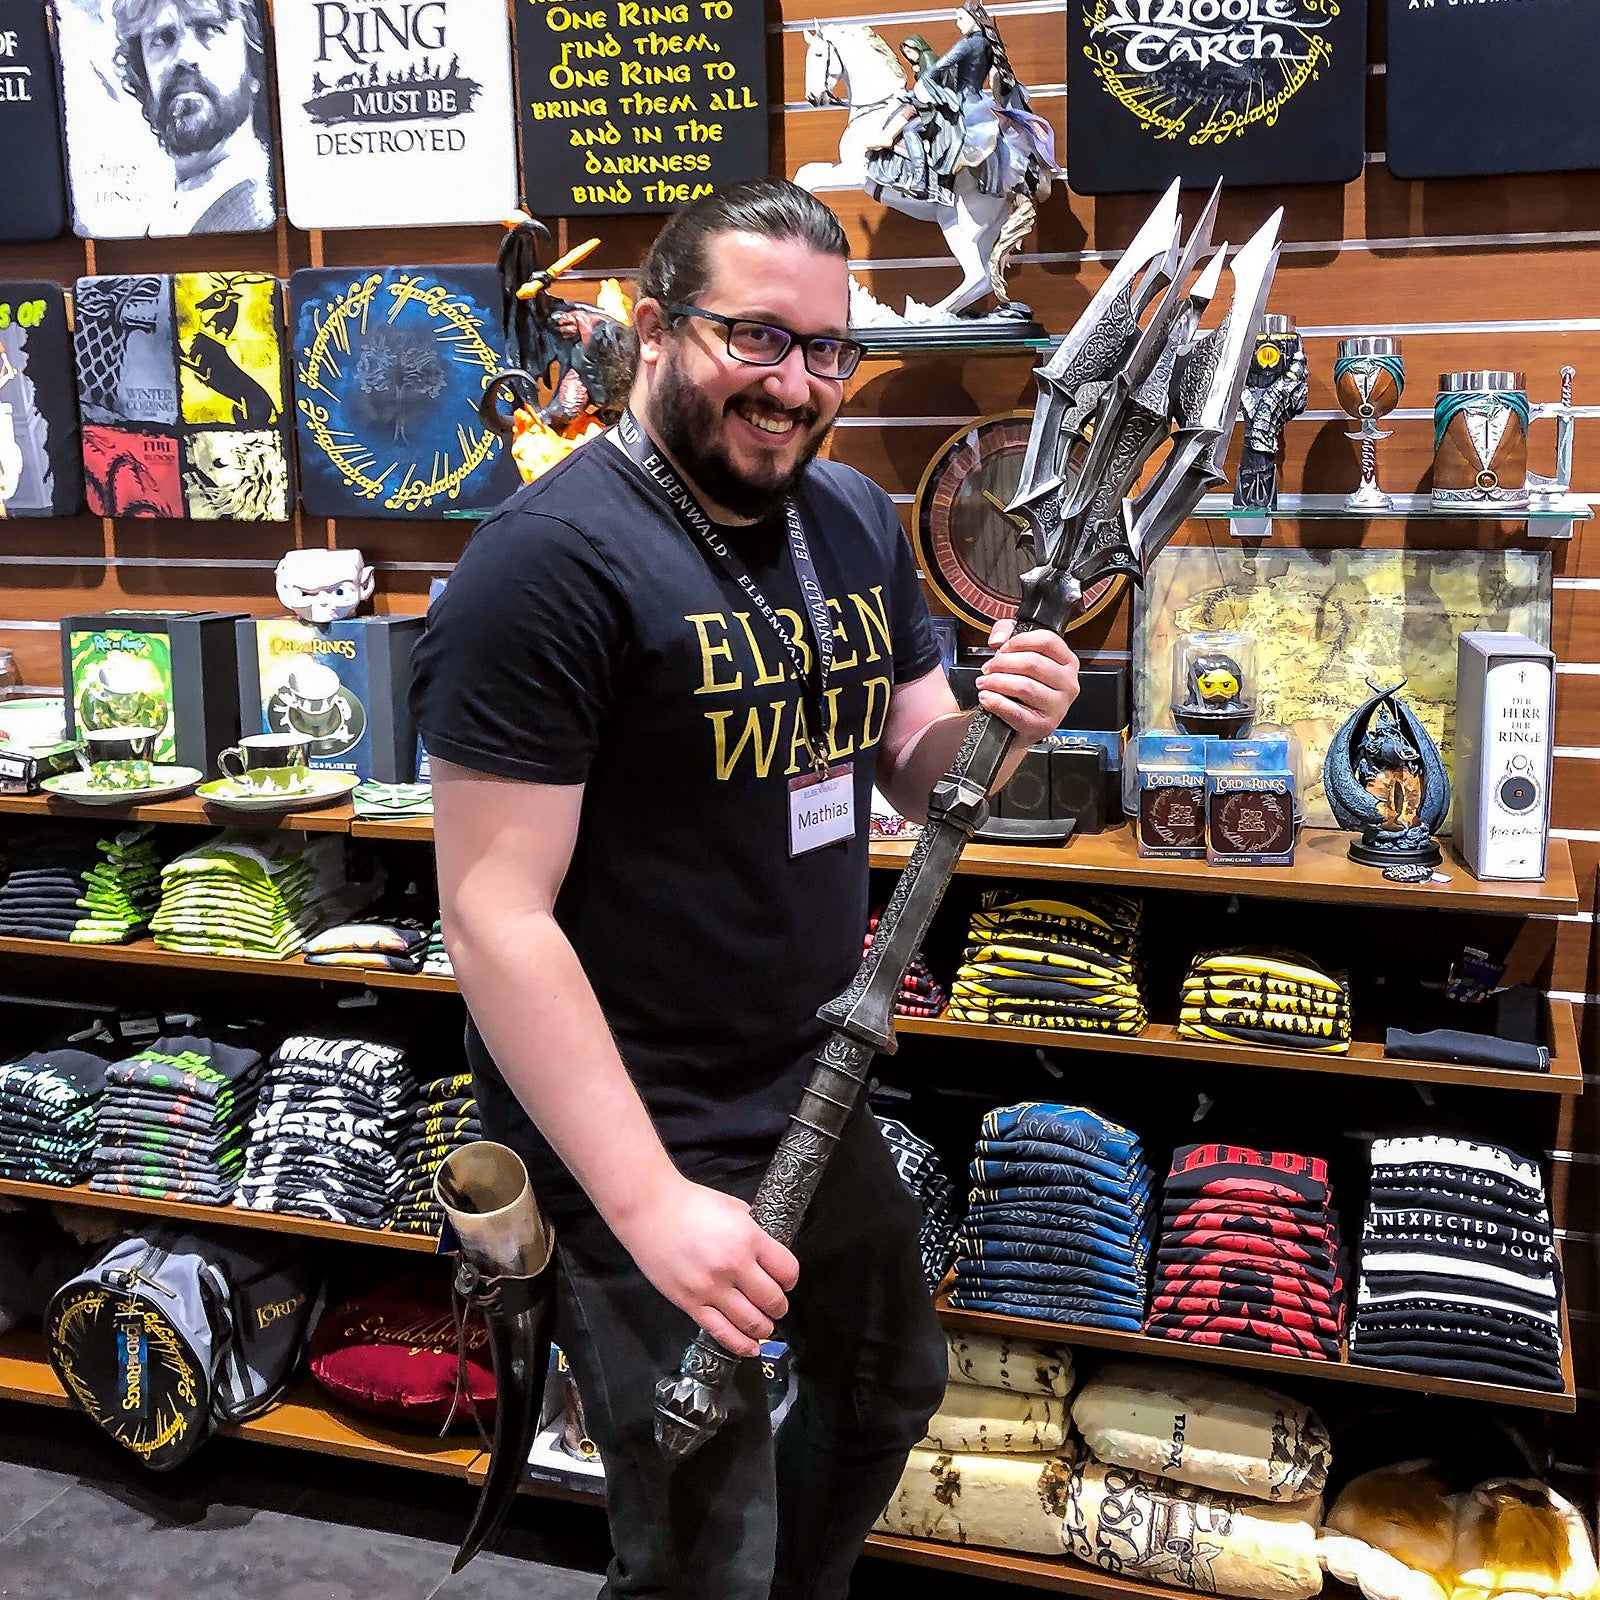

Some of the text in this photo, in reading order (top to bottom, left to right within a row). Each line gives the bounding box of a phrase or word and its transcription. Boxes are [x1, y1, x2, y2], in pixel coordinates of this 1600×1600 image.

[546, 0, 734, 32] One Ring to
[312, 1, 447, 64] RING
[561, 31, 721, 66] find them,
[549, 61, 736, 90] One Ring to
[352, 88, 457, 116] MUST BE
[531, 86, 759, 120] bring them all
[316, 129, 466, 156] DESTROYED
[569, 118, 723, 147] and in the
[584, 150, 712, 175] darkness
[571, 178, 632, 204] bind
[17, 299, 48, 328] OF
[641, 453, 729, 558] ELBENWALD
[312, 638, 357, 660] RINGS
[684, 585, 892, 694] ELBEN
[1503, 708, 1540, 719] HERR
[704, 676, 891, 781] WALD
[1499, 732, 1543, 743] RINGE
[1146, 772, 1174, 788] LORD
[1181, 774, 1206, 787] RING
[1215, 777, 1244, 793] LORD
[1253, 777, 1286, 793] RINGS
[798, 802, 849, 830] Mathias
[122, 1364, 142, 1410] RINGS
